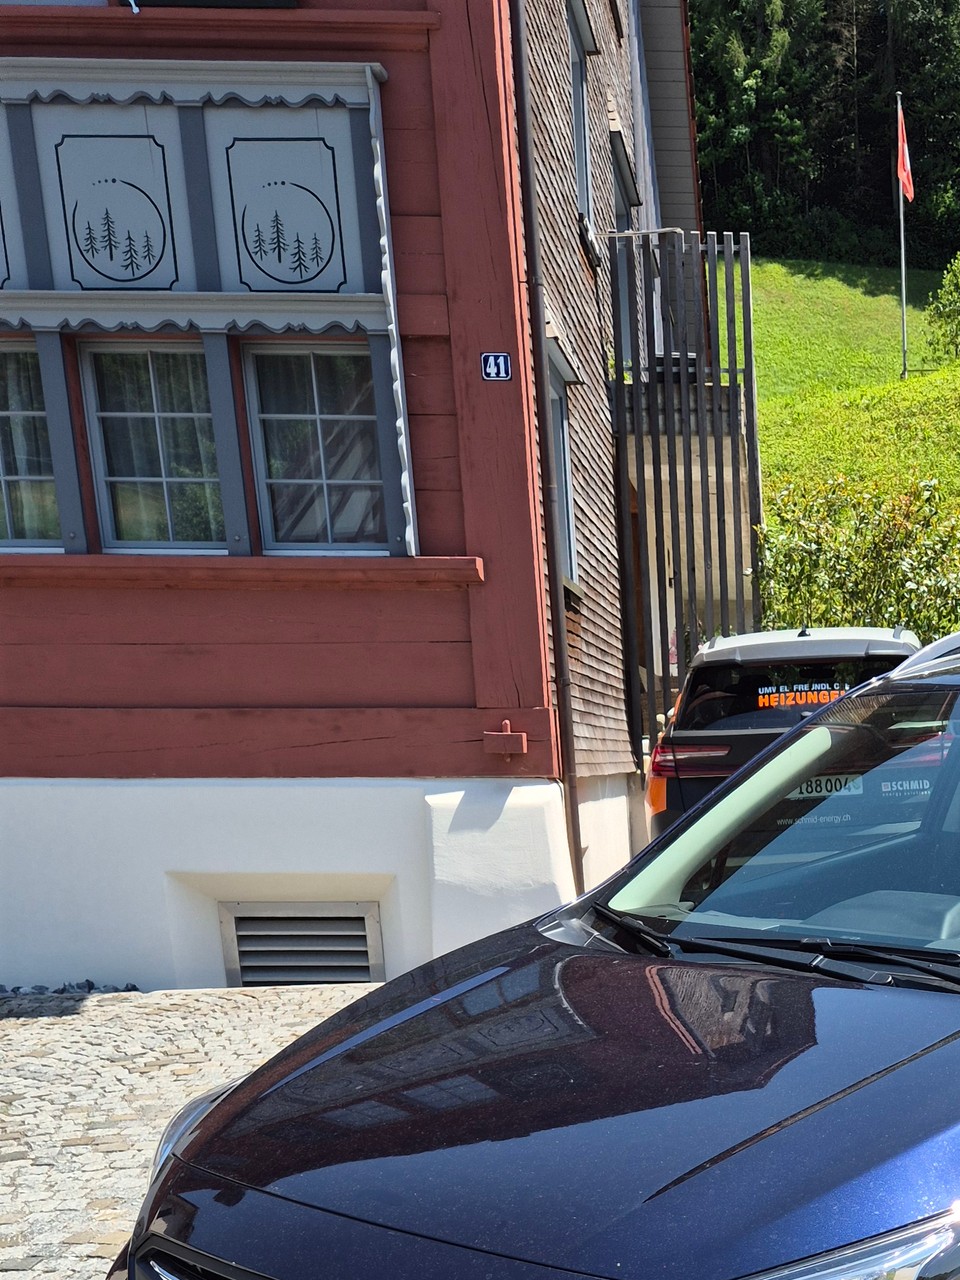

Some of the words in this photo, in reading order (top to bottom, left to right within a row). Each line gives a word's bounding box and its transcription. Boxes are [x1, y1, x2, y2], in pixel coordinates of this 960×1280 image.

[486, 355, 507, 377] 41
[758, 690, 845, 707] HEIZUNGE
[891, 779, 930, 791] SCHMID
[776, 813, 851, 827] www.schmid-energy.ch
